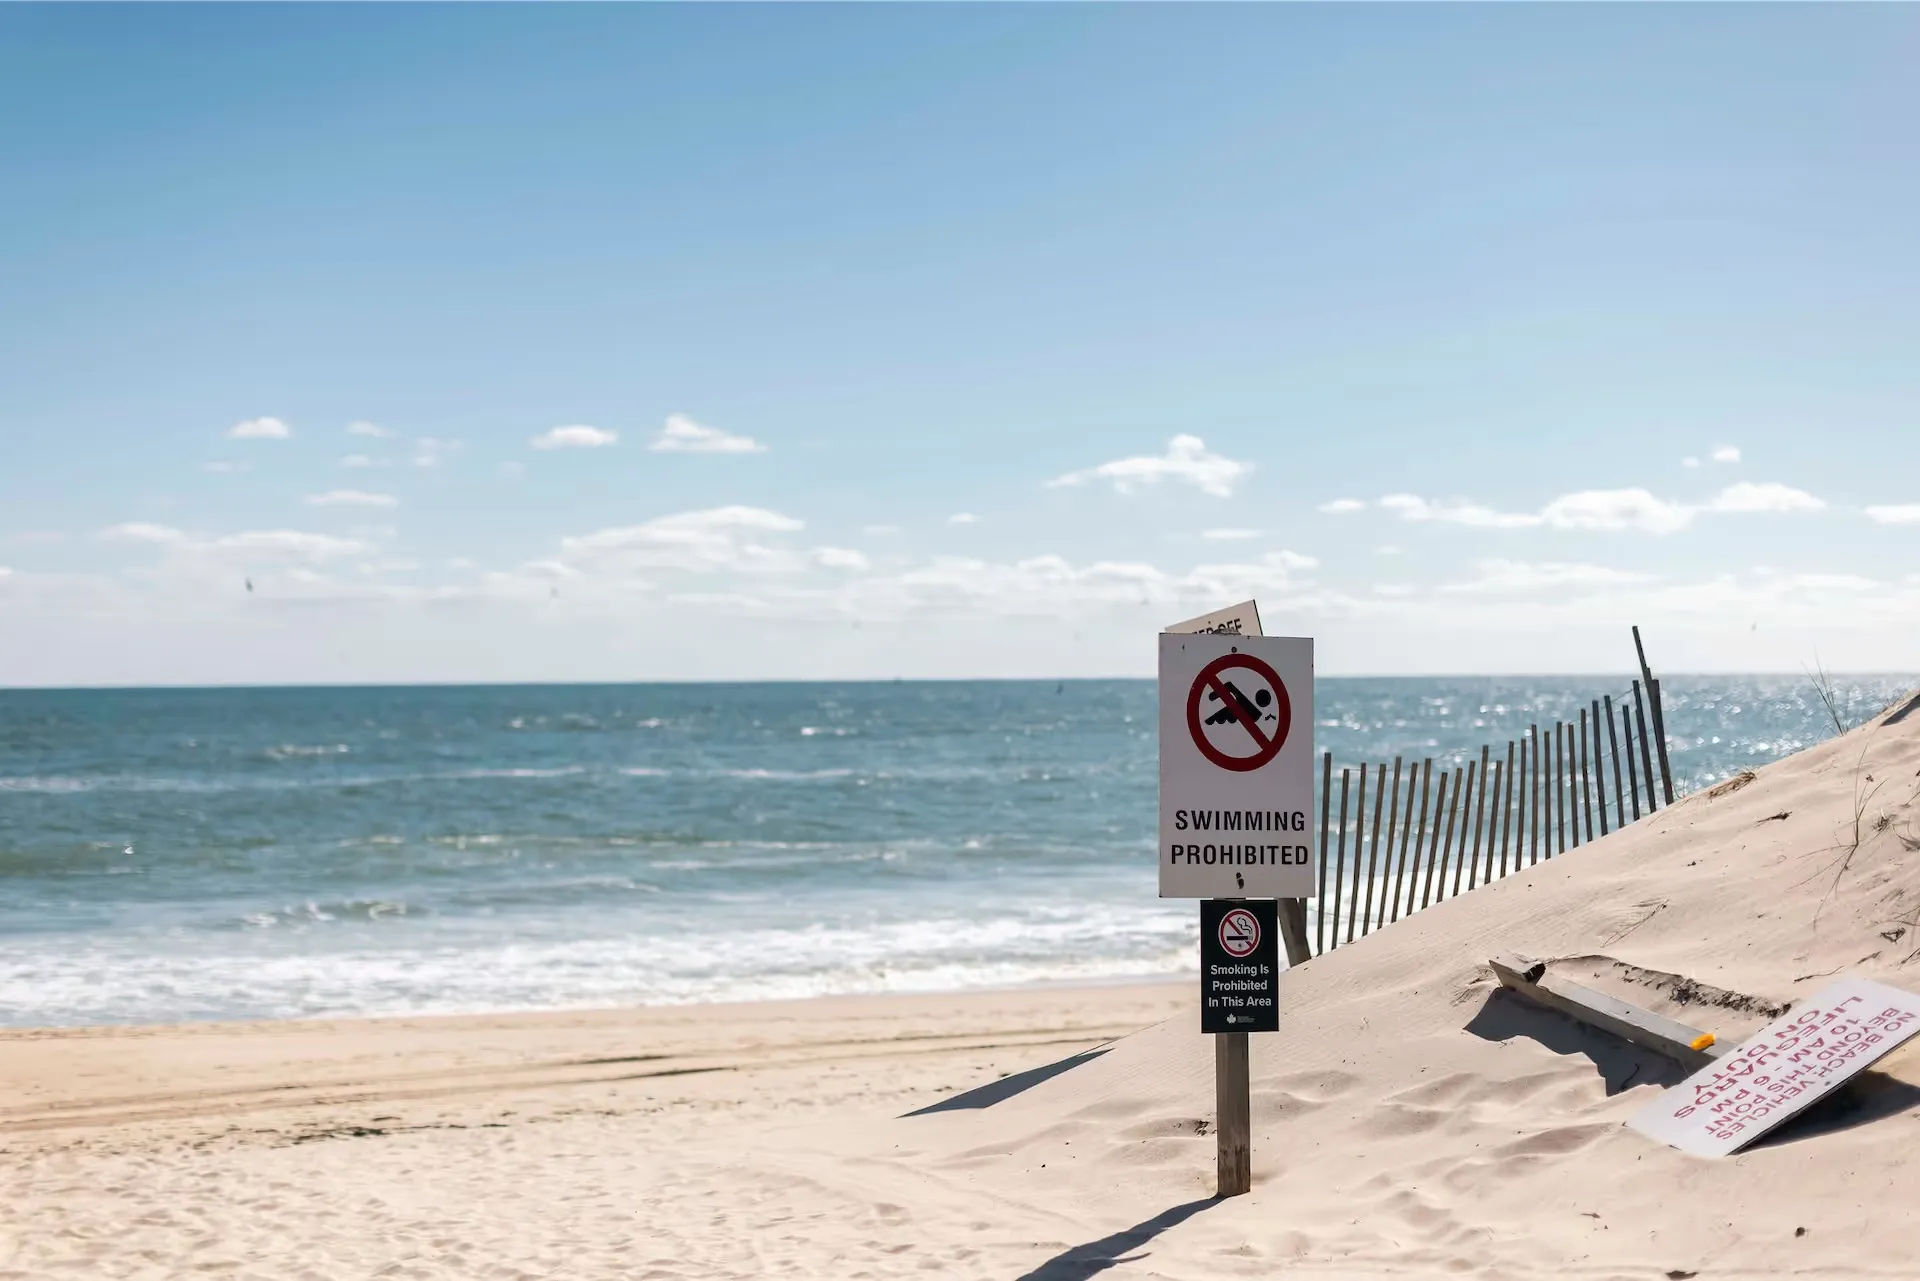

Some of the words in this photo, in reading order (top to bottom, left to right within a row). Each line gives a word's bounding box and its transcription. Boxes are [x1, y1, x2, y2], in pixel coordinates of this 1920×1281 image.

[1175, 810, 1305, 831] SWIMMING
[1171, 844, 1308, 865] PROHIBITED
[1210, 964, 1257, 977] Smoking
[1260, 964, 1269, 975] Is
[1212, 980, 1268, 991] Prohibited
[1208, 997, 1219, 1007] In
[1221, 996, 1244, 1007] This
[1246, 996, 1272, 1007] Area
[1775, 1010, 1820, 1038] ON
[1817, 1007, 1900, 1060] BEYOND
[1830, 1019, 1860, 1035] 10
[1884, 1012, 1917, 1031] NO
[1673, 996, 1863, 1118] LIFEGUARDS
[1787, 1037, 1825, 1063] AM
[1818, 1033, 1884, 1077] BEACH
[1694, 1043, 1769, 1095] DUTY
[1753, 1075, 1771, 1086] 6
[1767, 1064, 1817, 1092] THIS
[1710, 1088, 1751, 1113] PM
[1716, 1080, 1816, 1139] VEHICLES
[1704, 1094, 1767, 1135] POINT
